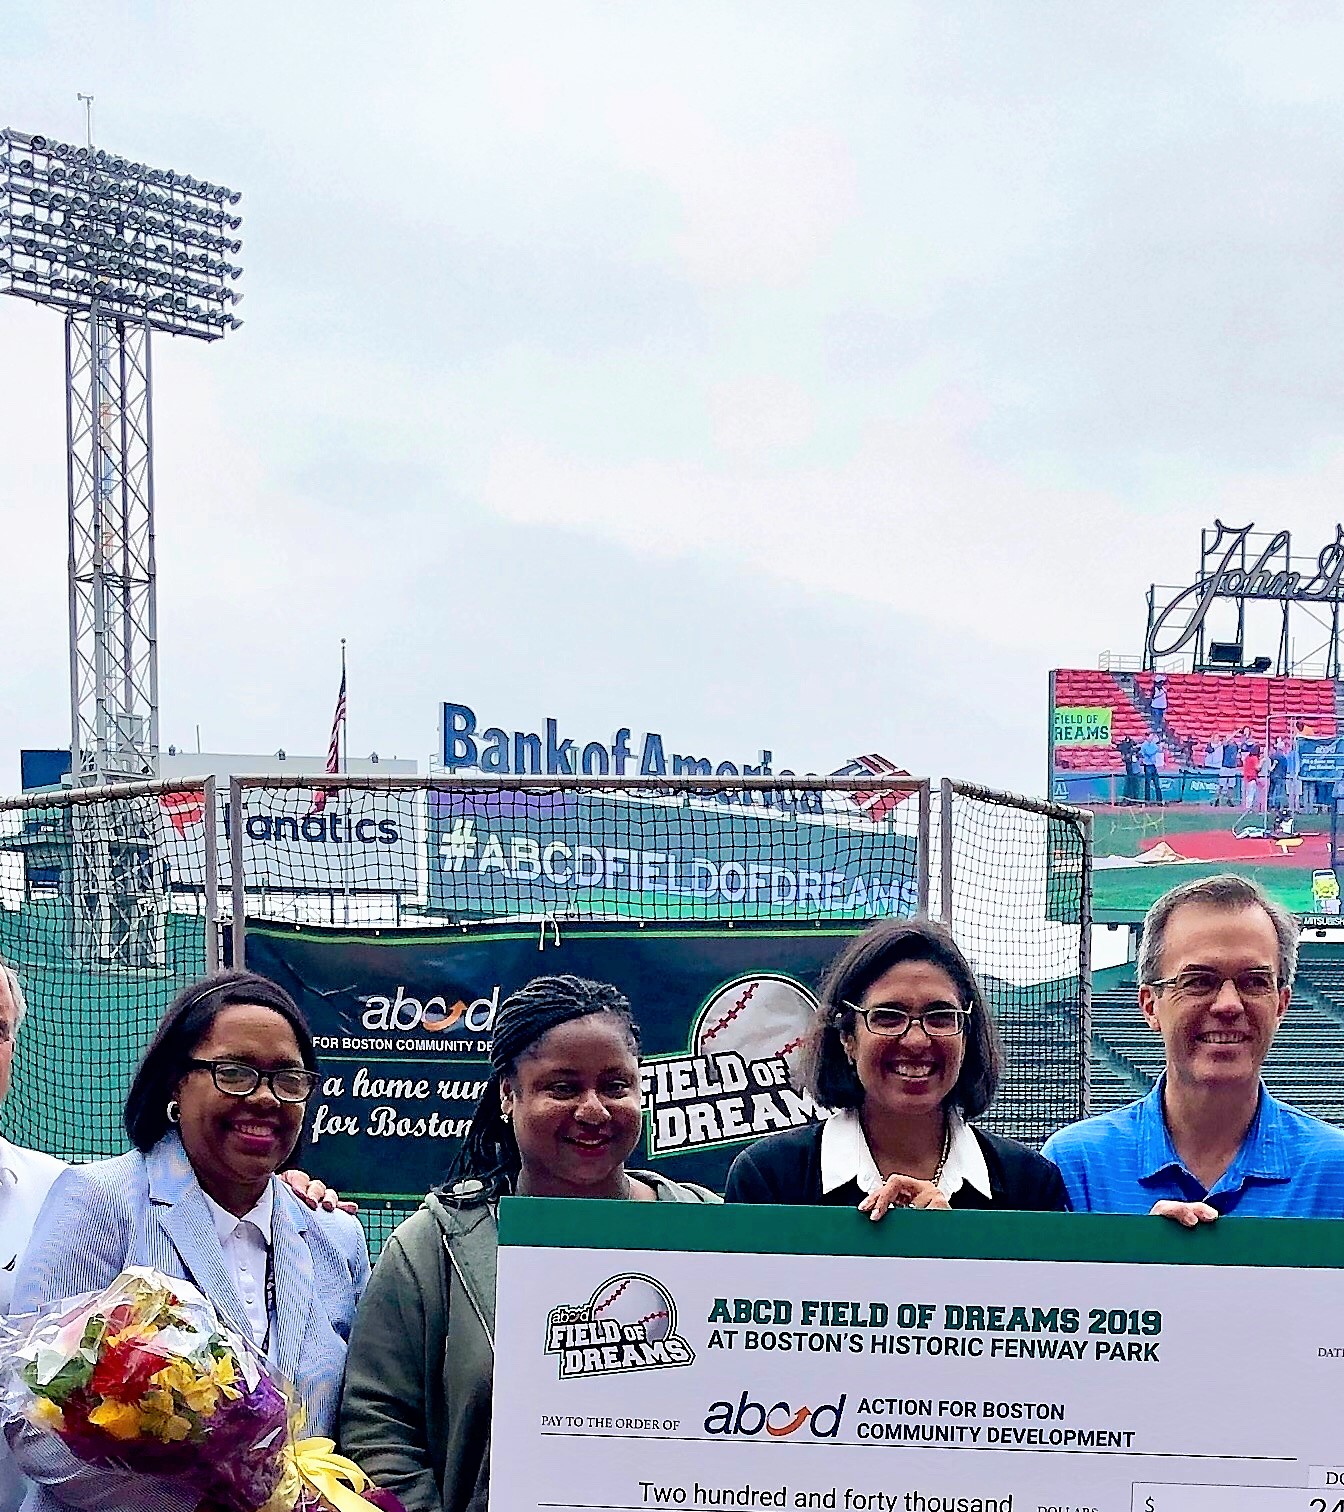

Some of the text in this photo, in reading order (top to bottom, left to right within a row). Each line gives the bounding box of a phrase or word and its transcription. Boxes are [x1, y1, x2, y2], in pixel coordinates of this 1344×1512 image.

[1148, 518, 1302, 656] John
[1054, 713, 1098, 724] FIELD OF
[439, 701, 826, 815] Bank of America
[440, 820, 918, 914] #ABCDFIELDOFDREAMS
[362, 986, 500, 1031] abcd
[312, 1037, 338, 1048] FOR
[343, 1038, 392, 1050] BOSTON
[396, 1039, 473, 1051] COMMUNITY
[323, 1077, 344, 1096] a
[353, 1068, 430, 1099] home
[640, 1054, 789, 1106] FIELD OF
[312, 1105, 473, 1143] for Boston
[656, 1087, 836, 1149] DREAM
[552, 1308, 590, 1323] abcd
[708, 1298, 1162, 1336] ABCD FIELD OF DREAMS 2019
[550, 1320, 645, 1349] FIELD OF
[708, 1330, 1160, 1362] AT BOSTON'S HISTORIC FENWAY PARK
[564, 1340, 690, 1373] DREAMS
[541, 1415, 680, 1431] PAY TO THE ORDER OF
[704, 1390, 847, 1438] abcd
[857, 1398, 1065, 1421] ACTION FOR BOSTON
[857, 1423, 1135, 1448] COMMUNITY DEVELOPMENT
[639, 1482, 686, 1503] Two
[694, 1483, 787, 1507] hundred
[794, 1487, 836, 1509] and
